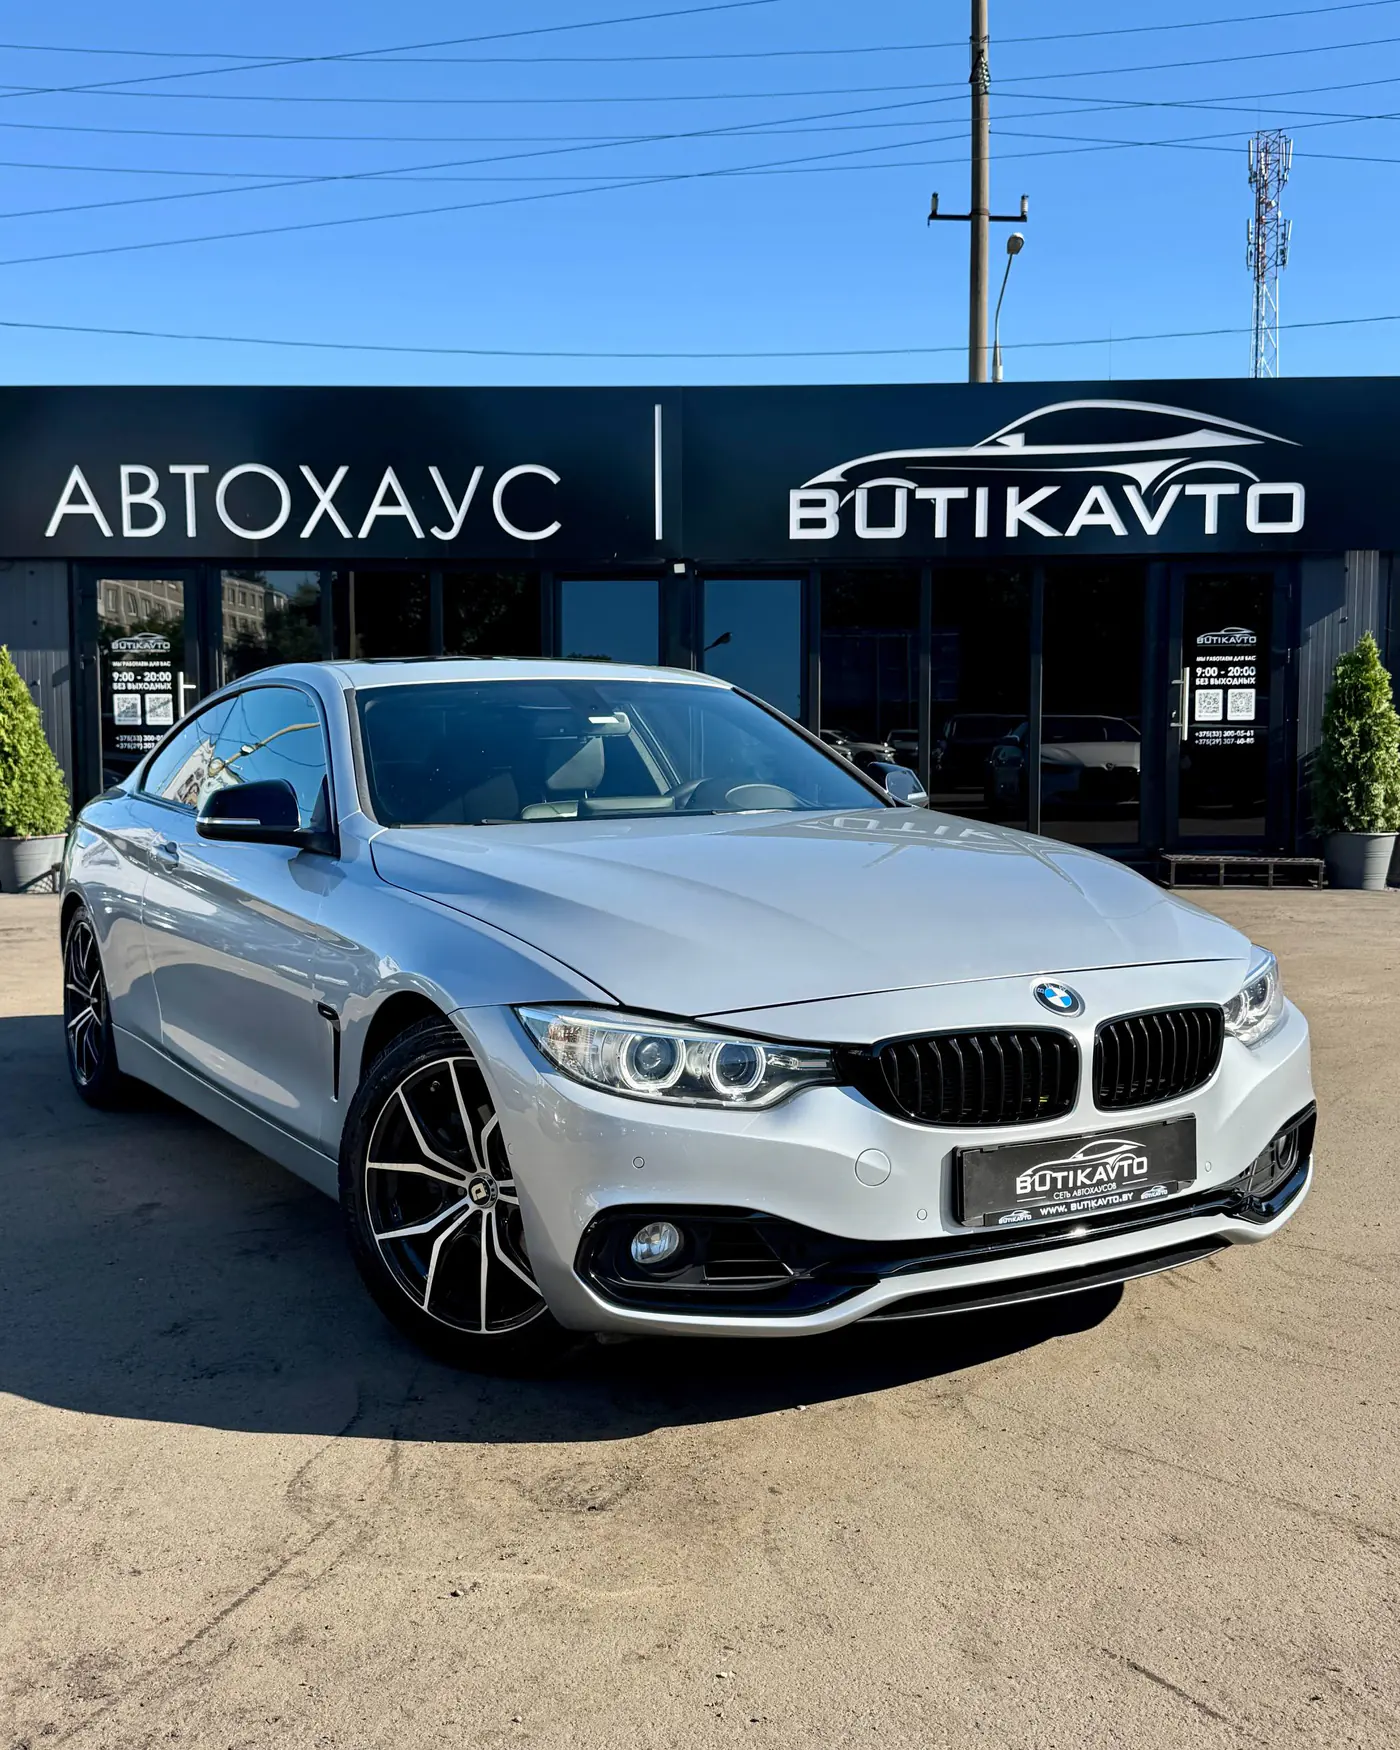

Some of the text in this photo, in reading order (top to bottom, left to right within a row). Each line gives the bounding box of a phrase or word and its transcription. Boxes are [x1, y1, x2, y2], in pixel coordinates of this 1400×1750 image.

[45, 462, 562, 541] АВТОХАУС
[789, 482, 1305, 540] BUTIKAVTO
[1196, 636, 1257, 644] BUTIKAVTO
[112, 671, 135, 682] 9:00
[143, 671, 172, 682] 20:00
[1196, 667, 1218, 677] 9:00
[1227, 666, 1256, 676] 20:00
[112, 682, 172, 690] БЕЗ ВЫХОДНЫХ
[1196, 677, 1256, 686] БЕЗ ВЫХОДНЫХ
[1016, 1156, 1148, 1195] BUTIKAVTO
[1053, 1182, 1117, 1200] СЕТЬ АВТОХАУСОВ
[1040, 1192, 1134, 1216] WWW. BUTIKAVTO.BY
